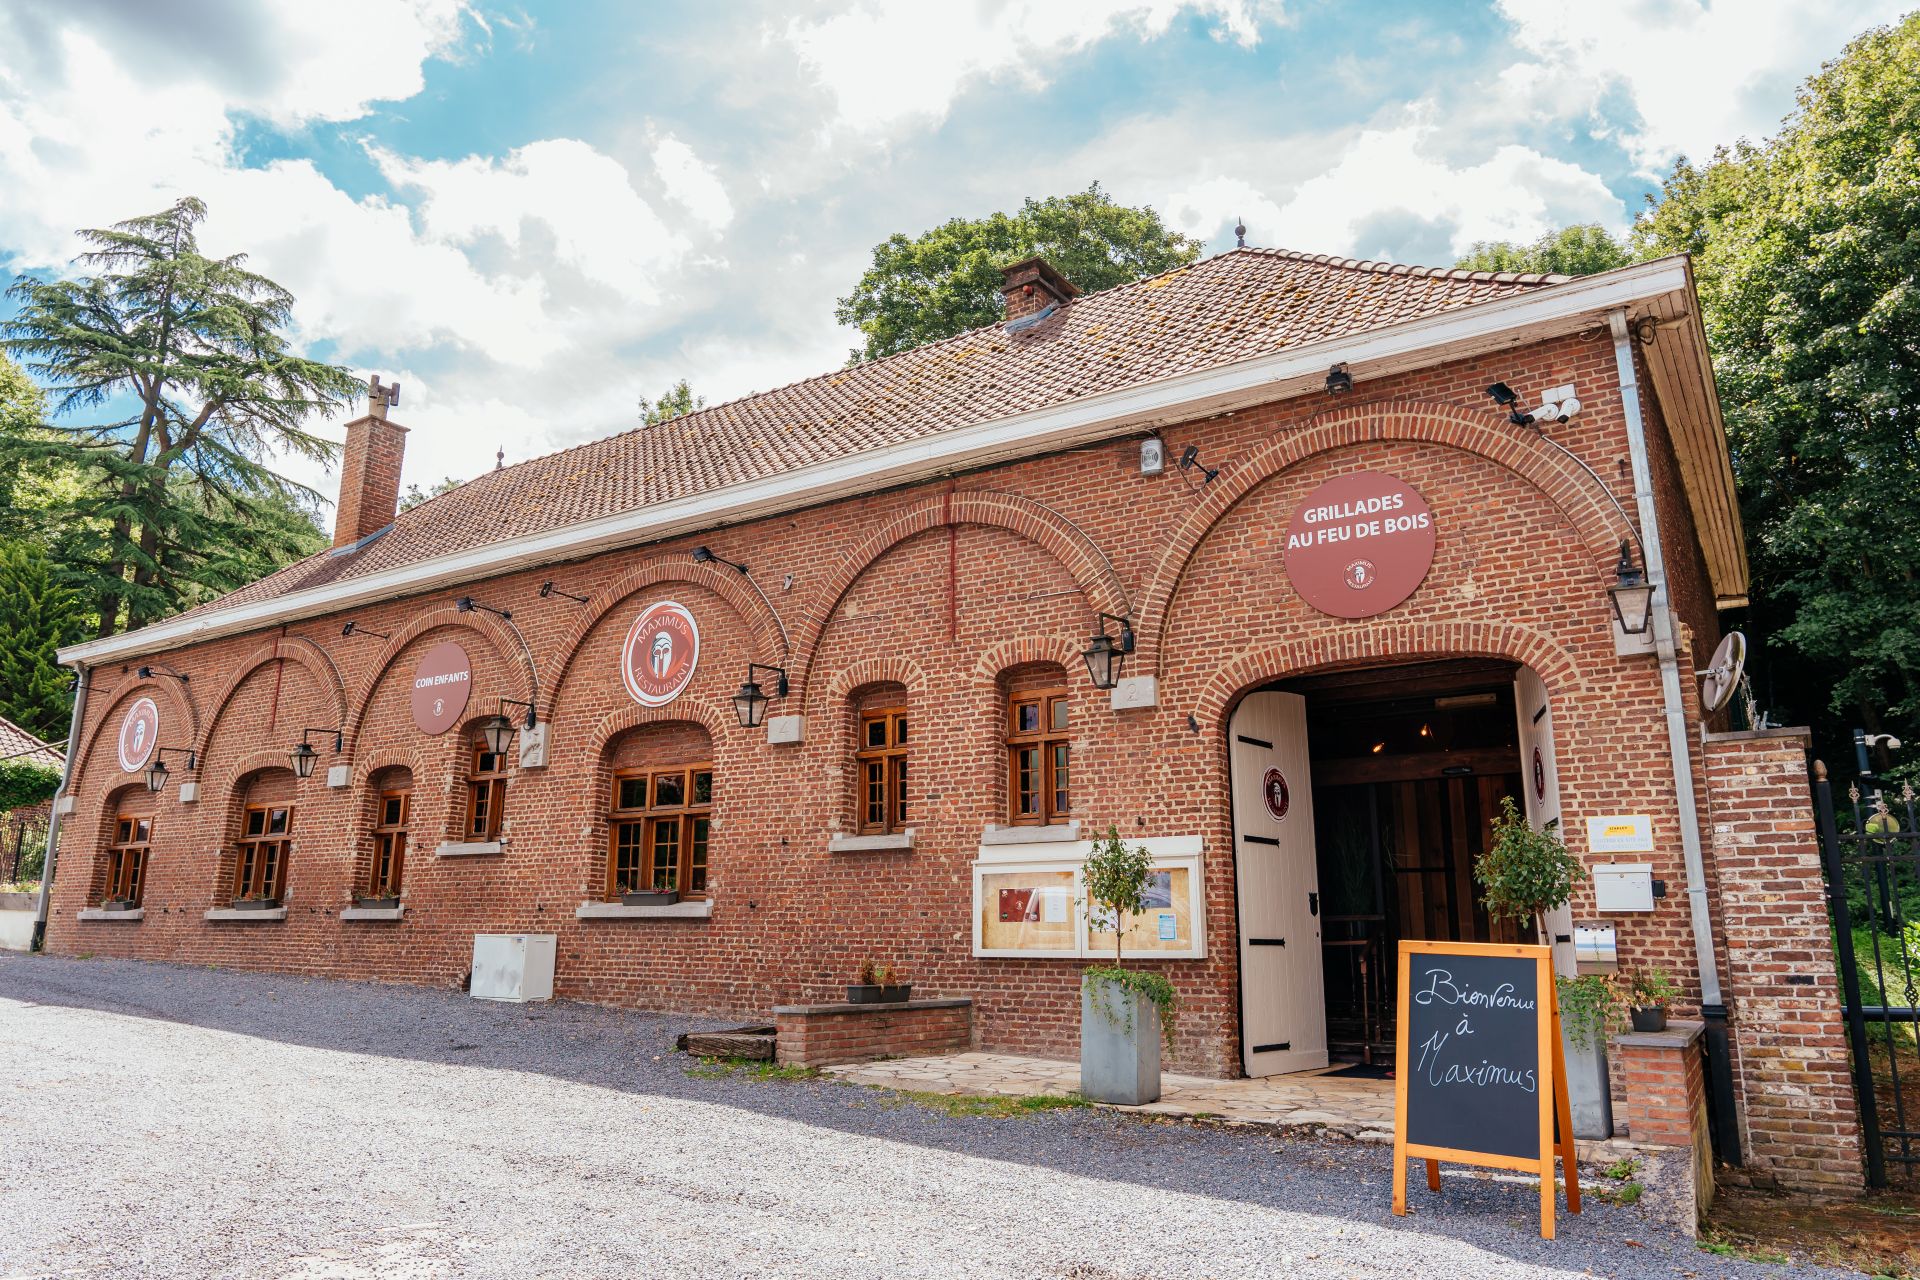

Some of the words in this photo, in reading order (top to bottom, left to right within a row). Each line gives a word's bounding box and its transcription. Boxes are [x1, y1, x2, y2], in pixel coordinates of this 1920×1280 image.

[1303, 493, 1404, 524] GRILLADES
[1287, 531, 1313, 550] AU
[1317, 525, 1351, 545] FEU
[1355, 520, 1381, 539] DE
[1384, 512, 1430, 534] BOIS
[1346, 560, 1373, 572] MAXIMUS
[637, 615, 690, 644] MAXIMUS
[415, 676, 434, 689] COIN
[434, 670, 469, 686] ENFANTS
[634, 662, 690, 694] RESTAURANT
[1415, 968, 1535, 1010] Bienvenue
[1455, 1012, 1475, 1036] à
[1417, 1030, 1536, 1093] Maximus
